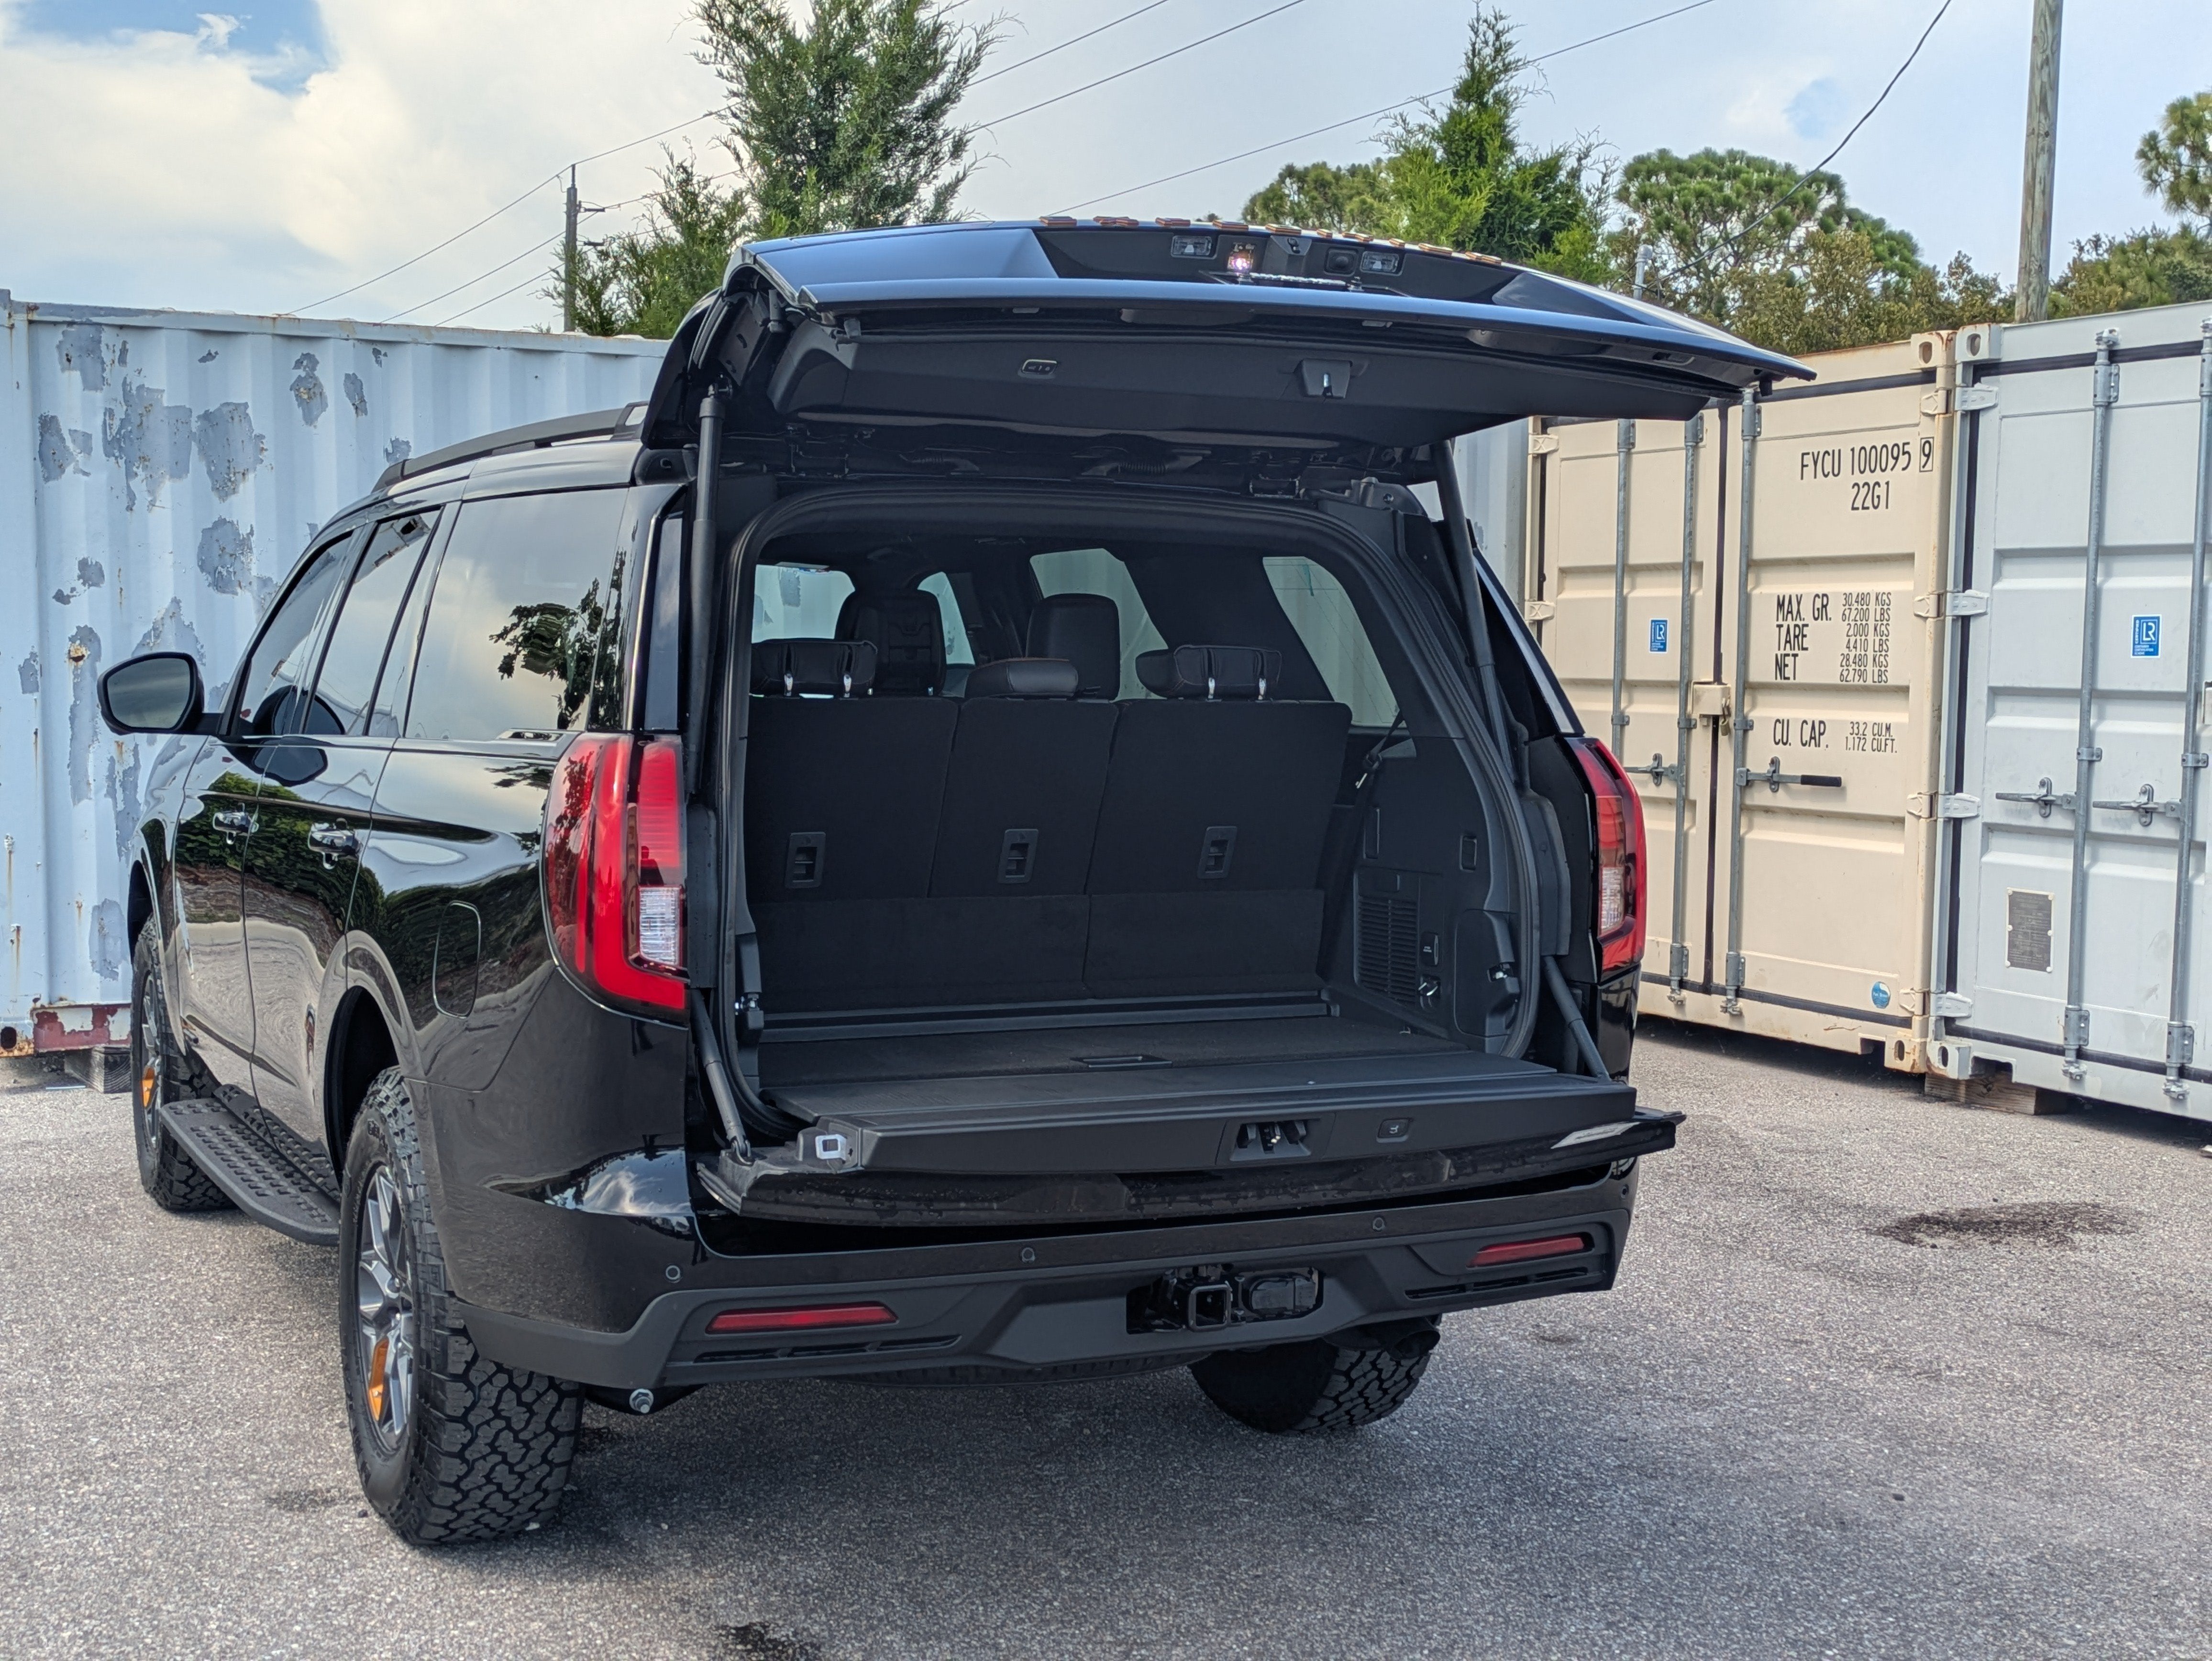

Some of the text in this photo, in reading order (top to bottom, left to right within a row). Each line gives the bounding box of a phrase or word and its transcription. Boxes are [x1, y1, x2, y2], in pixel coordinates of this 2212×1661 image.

[1800, 440, 1932, 480] FYCU 100095 9
[1851, 480, 1890, 510] 22G1
[1776, 593, 1832, 621] MAX. GR.
[1842, 592, 1891, 607] 30.480 KGS
[1841, 608, 1891, 622] 67.200 LBS
[1776, 624, 1809, 651] TARE
[1846, 623, 1890, 637] 2.000 KGS
[1846, 639, 1889, 653] 4.410 LBS
[1775, 653, 1799, 680] NET
[1840, 653, 1889, 668] 28.480 KGS
[1839, 669, 1888, 683] 62.790 LBS
[1773, 719, 1828, 748] CU. CAP.
[1849, 722, 1867, 736] 33.2
[1845, 737, 1866, 751] 1.172
